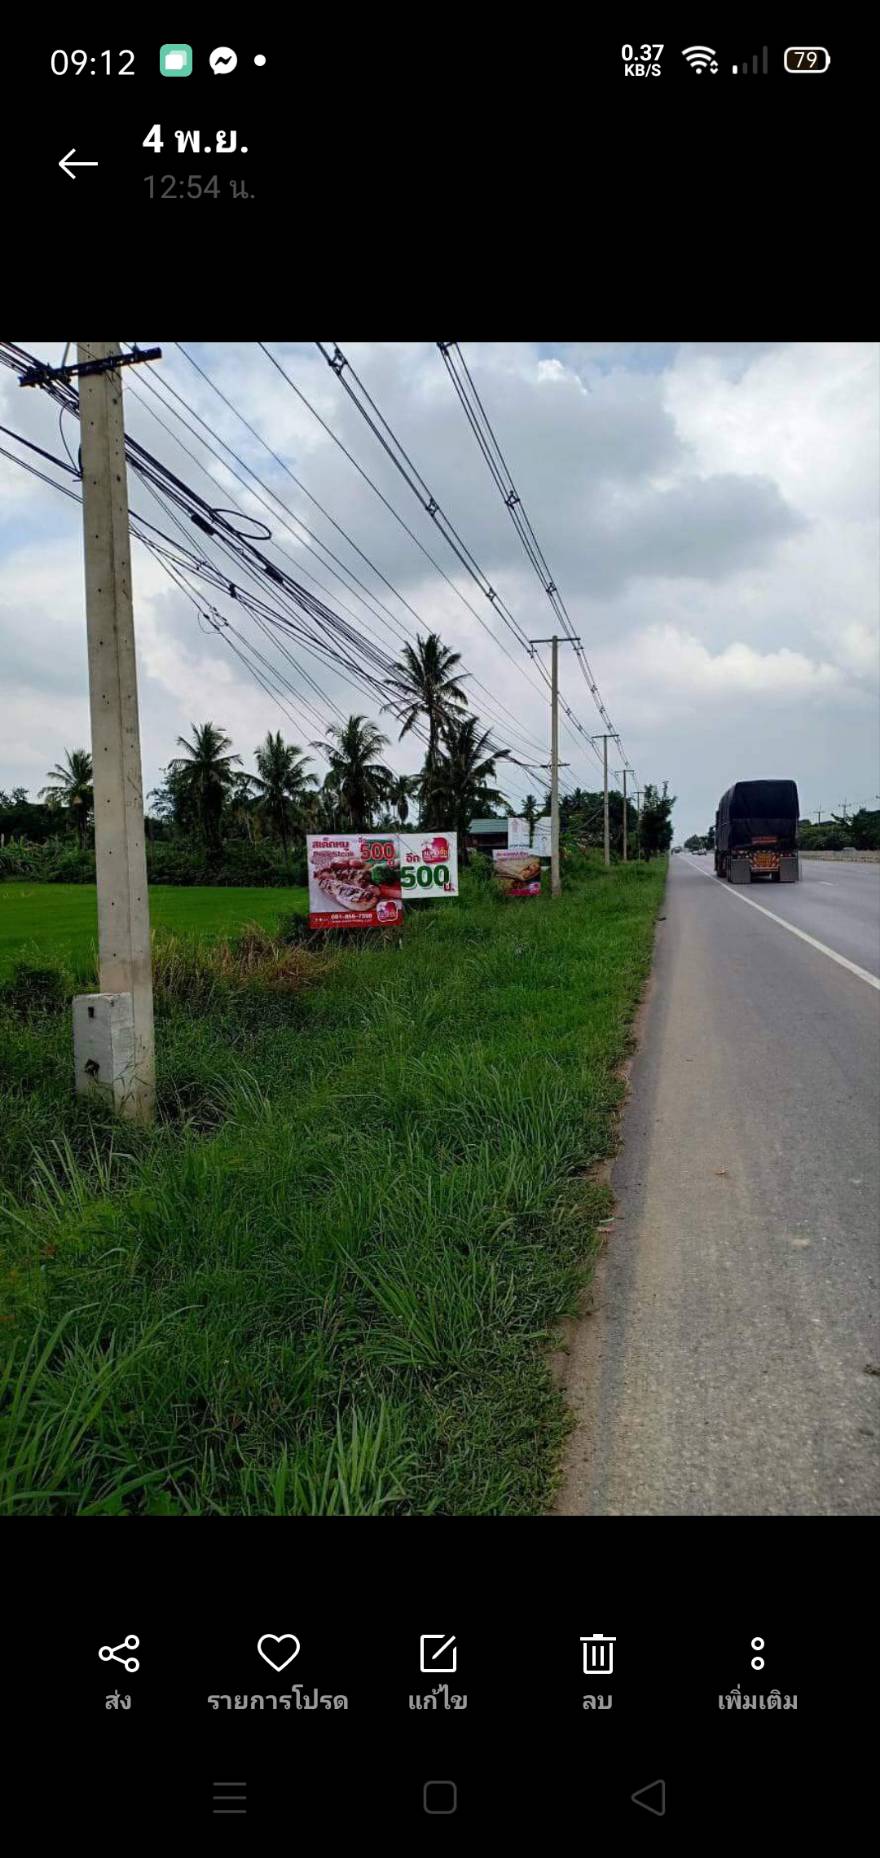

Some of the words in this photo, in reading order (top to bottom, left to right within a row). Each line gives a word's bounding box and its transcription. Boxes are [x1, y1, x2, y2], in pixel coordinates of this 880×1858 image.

[360, 842, 395, 861] 500
[405, 853, 421, 863] อีก
[401, 865, 450, 888] 500
